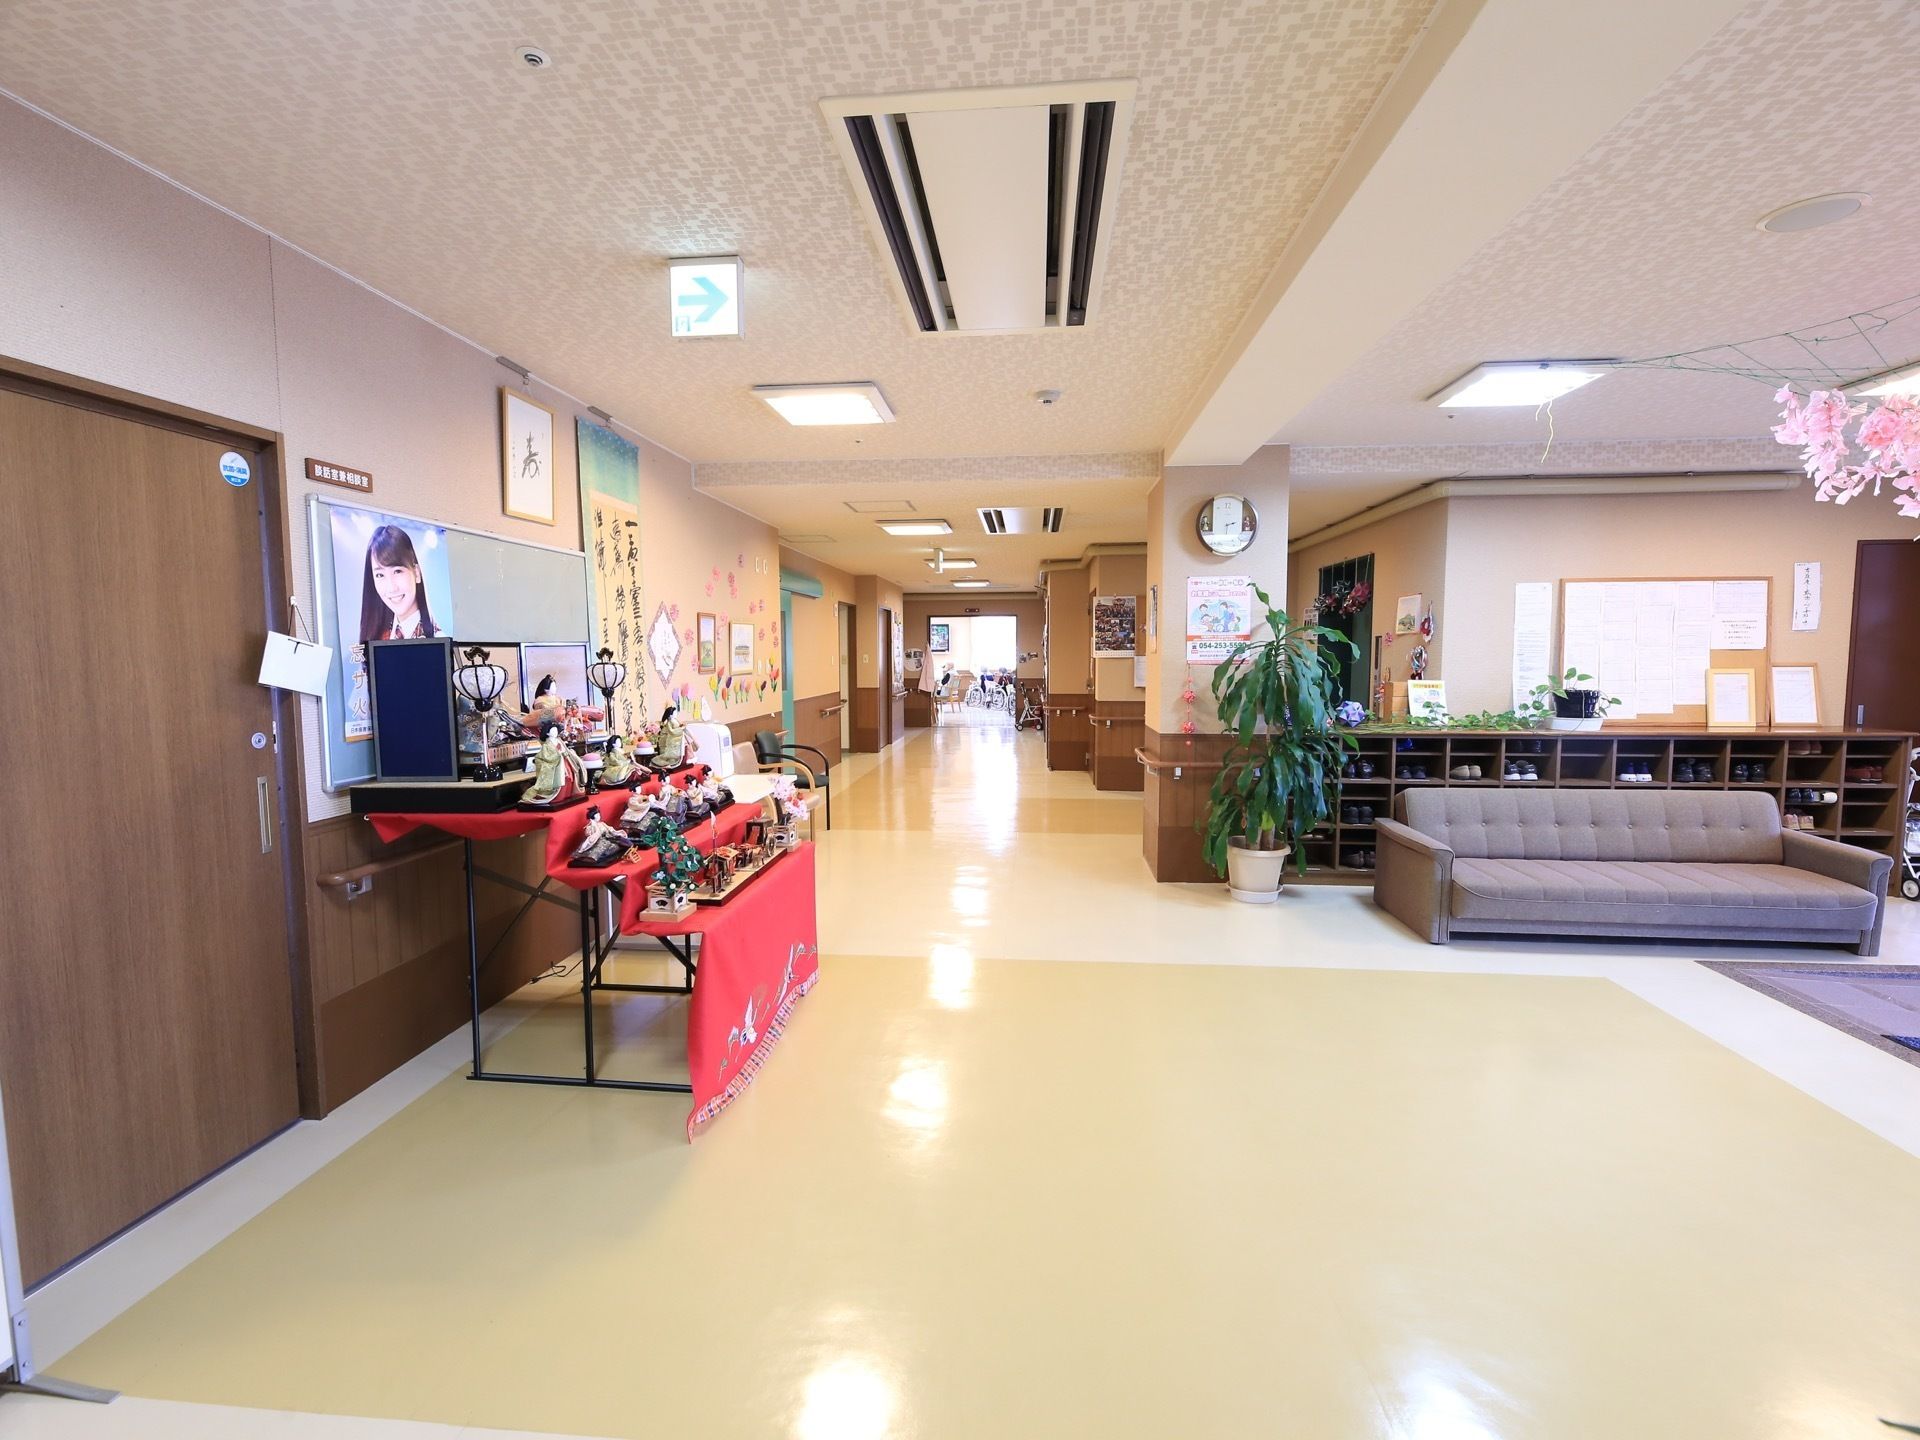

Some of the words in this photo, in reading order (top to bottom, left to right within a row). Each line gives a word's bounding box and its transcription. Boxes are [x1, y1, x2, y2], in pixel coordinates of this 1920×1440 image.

[314, 464, 369, 488] 談話室兼相談室
